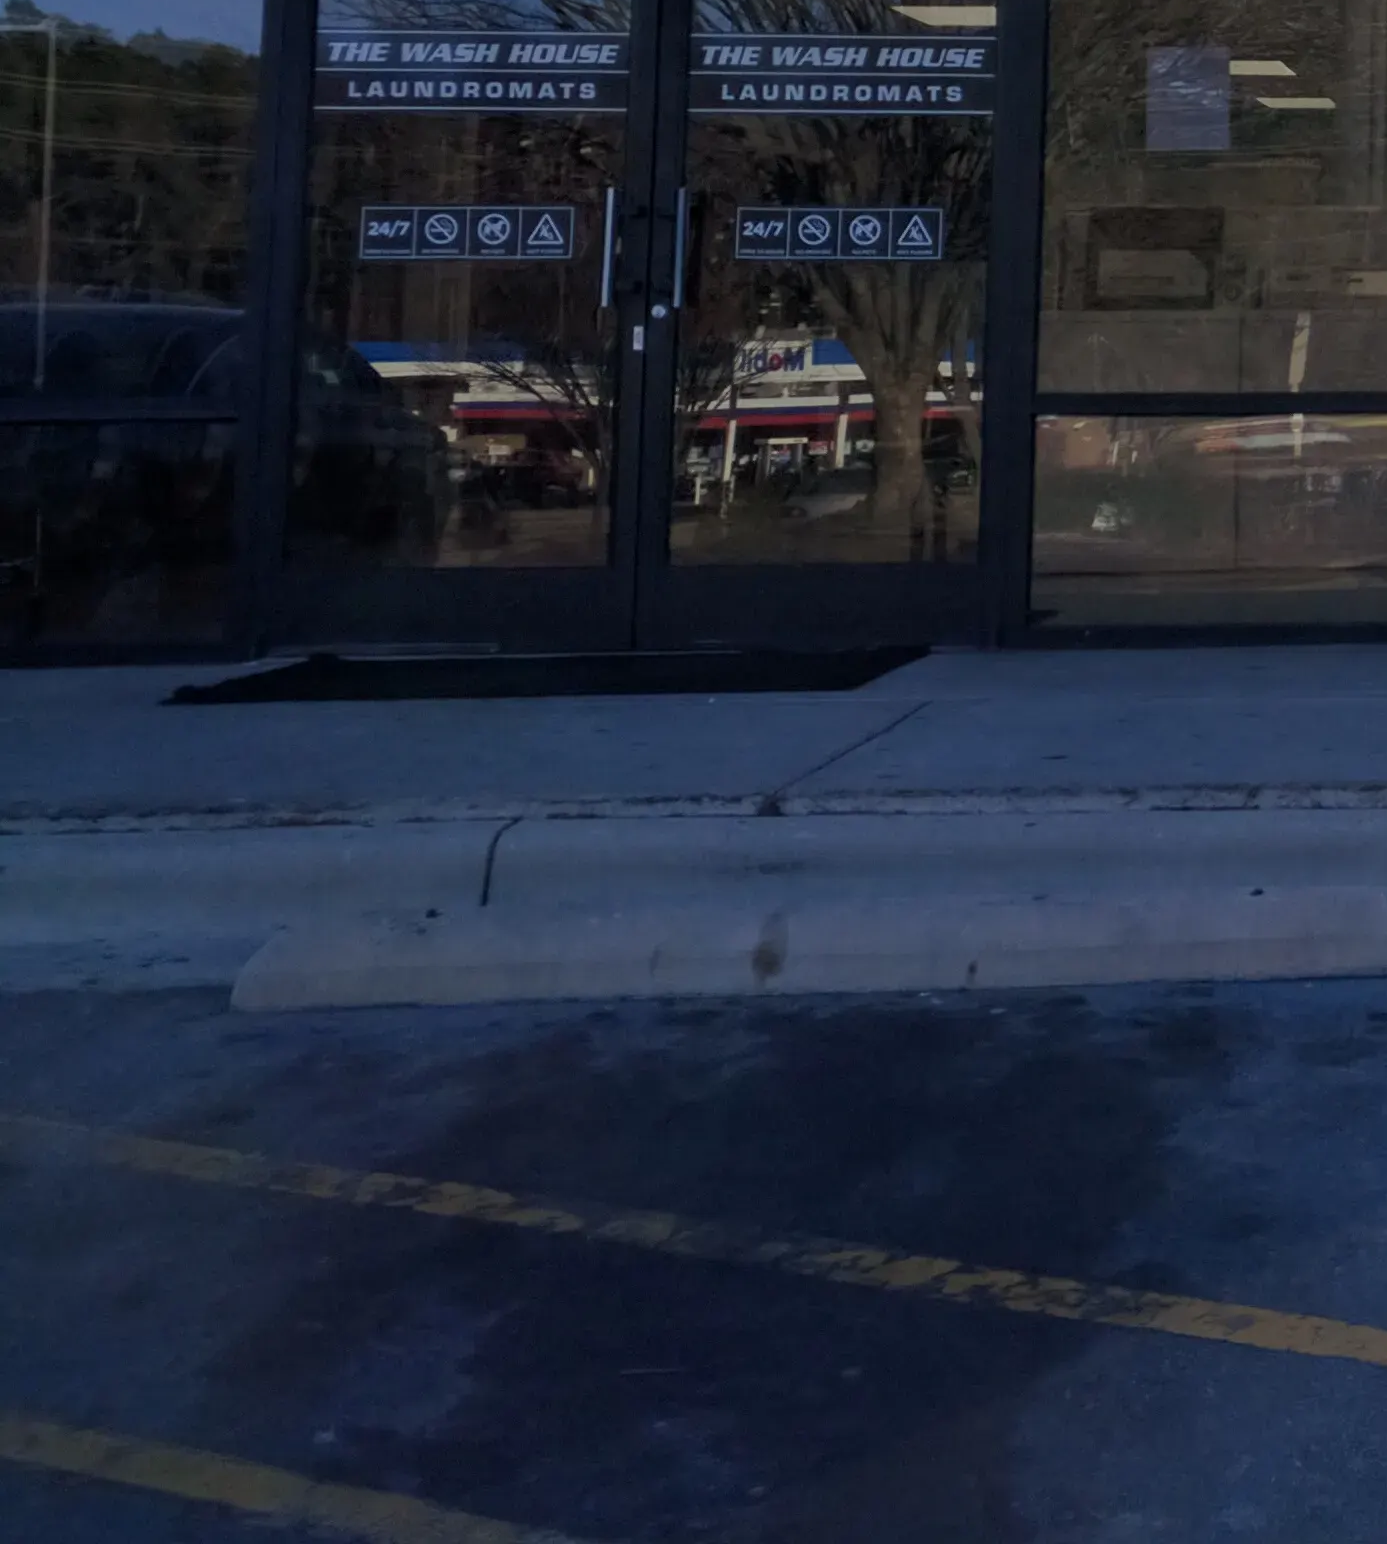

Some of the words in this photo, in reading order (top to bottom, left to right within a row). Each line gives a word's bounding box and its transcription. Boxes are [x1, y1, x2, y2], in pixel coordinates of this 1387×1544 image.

[328, 42, 391, 62] THE
[400, 42, 499, 63] WASH
[508, 44, 619, 64] HOUSE
[702, 45, 762, 66] THE
[772, 47, 868, 67] WASH
[876, 48, 985, 68] HOUSE
[348, 81, 597, 99] LAUNDROMATS
[721, 84, 963, 102] LAUNDROMATS
[367, 220, 411, 238] 24/7
[742, 220, 784, 238] 24/7
